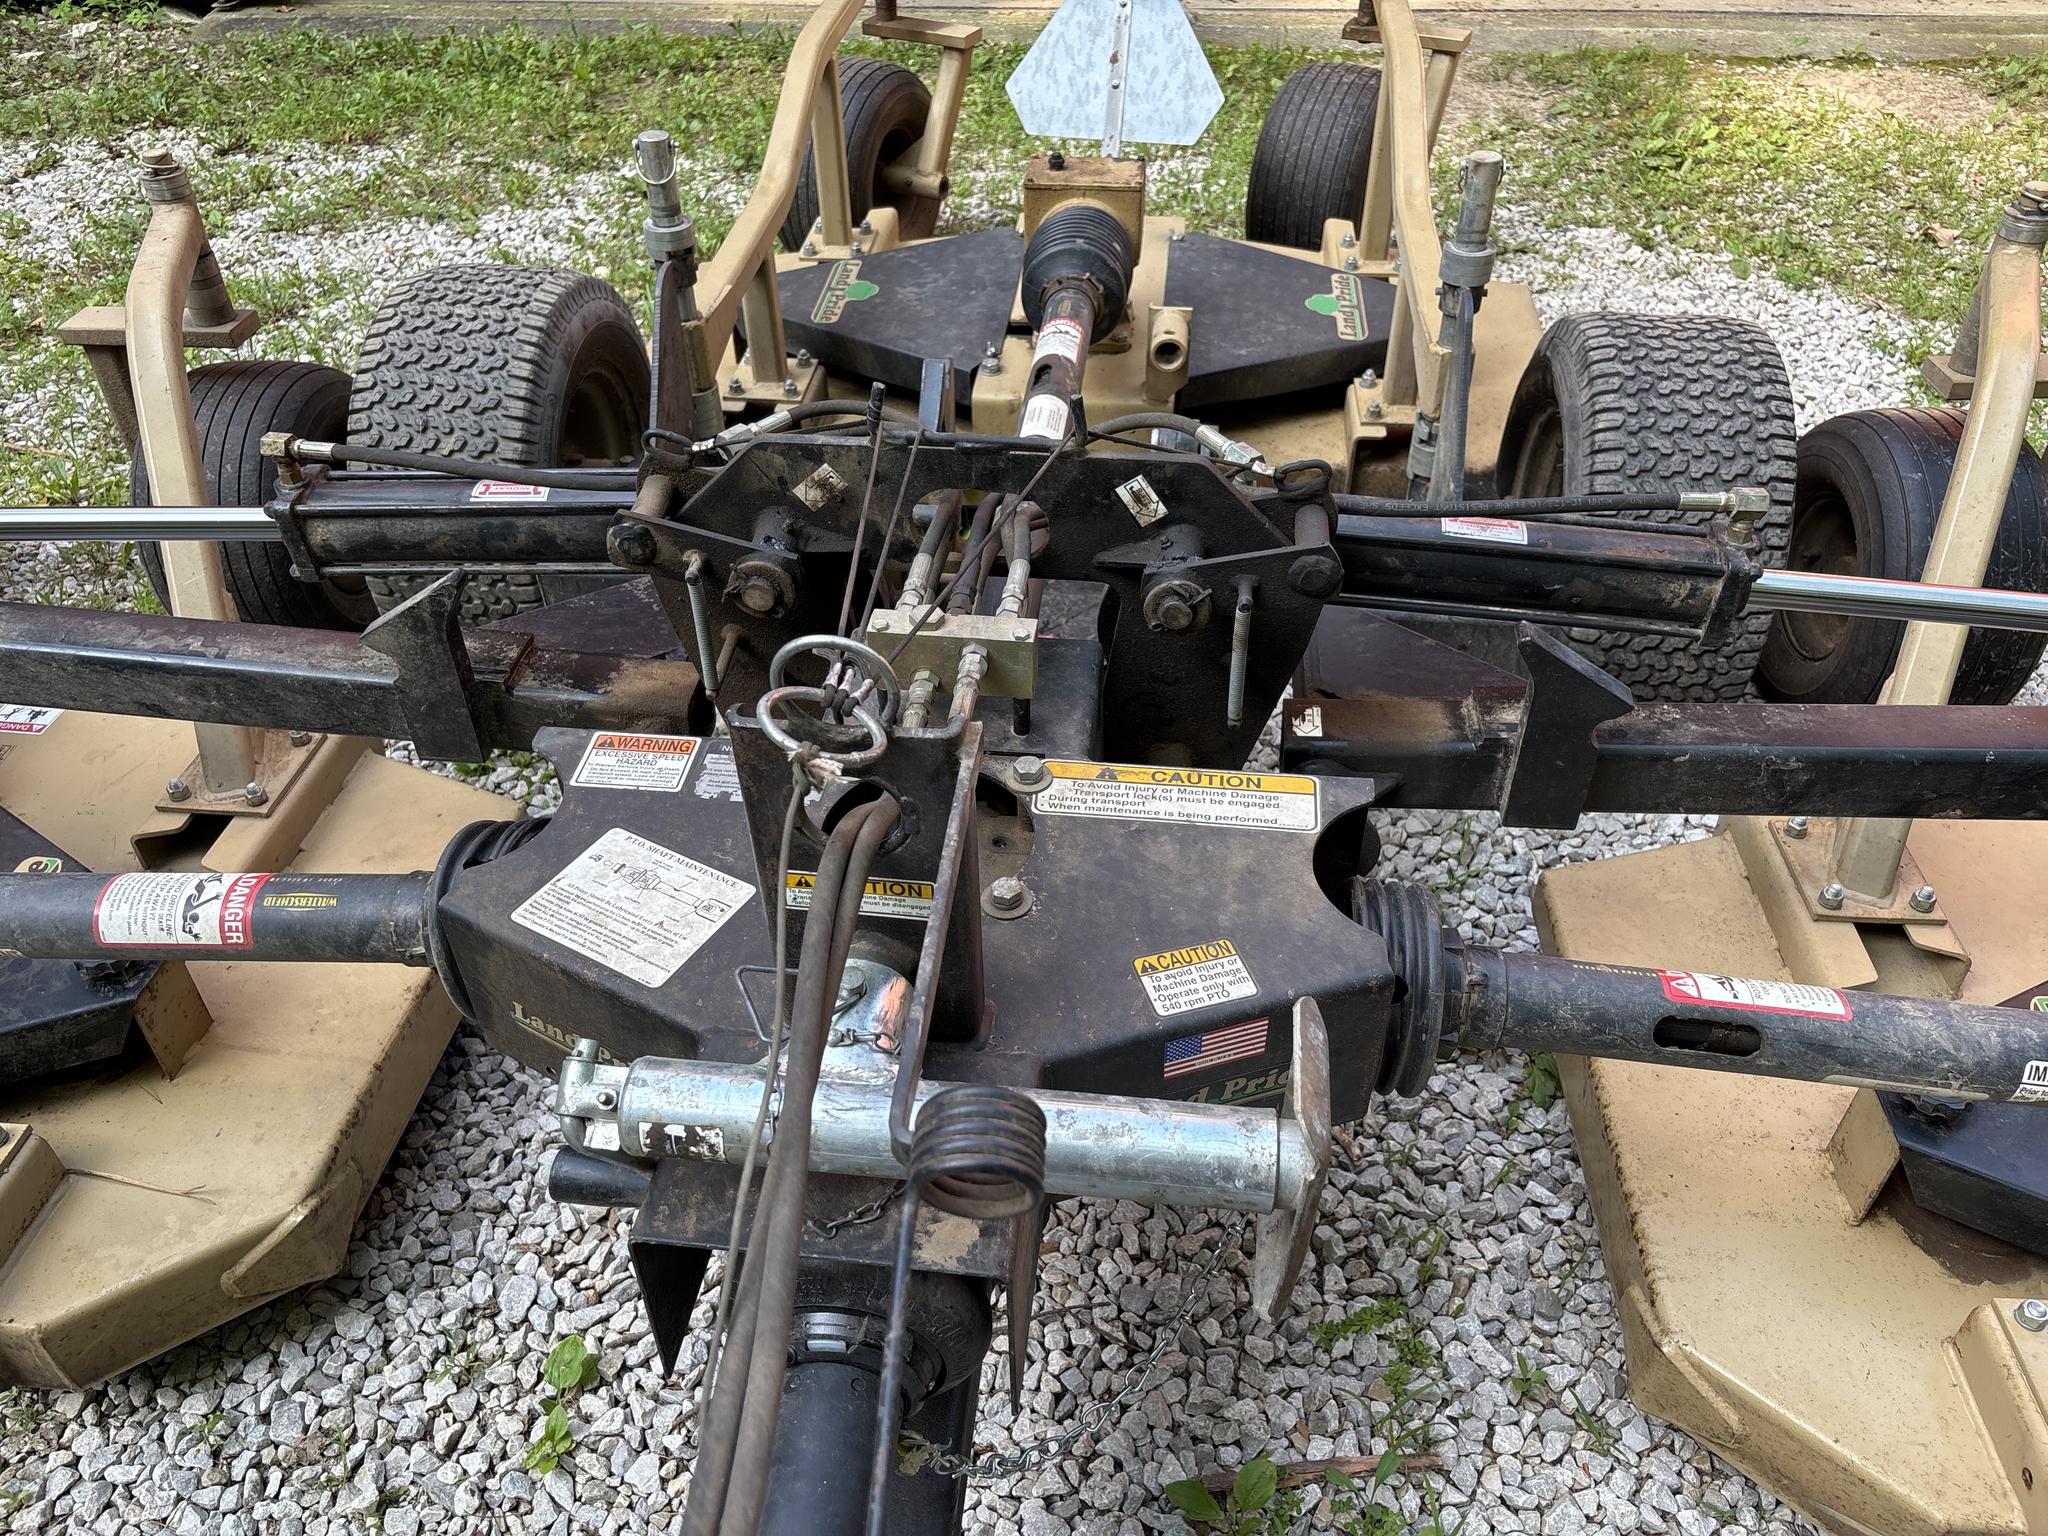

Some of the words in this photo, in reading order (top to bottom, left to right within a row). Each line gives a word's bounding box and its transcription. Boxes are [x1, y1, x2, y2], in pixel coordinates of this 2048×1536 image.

[837, 262, 860, 286] Land
[1334, 276, 1352, 302] Pride
[821, 294, 846, 322] Pride
[1338, 310, 1356, 337] Land
[1384, 502, 1428, 512] EXCEEDS
[1495, 500, 1526, 510] FLAME
[594, 750, 650, 759] EXCESSIVE
[618, 737, 691, 752] WARNING
[616, 758, 658, 766] HAZARD
[1151, 771, 1261, 788] CAUTION
[1049, 794, 1087, 804] During
[1092, 798, 1146, 807] transport
[1071, 780, 1084, 788] To
[1088, 782, 1121, 790] Avoid
[1124, 785, 1158, 794] Injury
[1178, 788, 1227, 797] Machine
[1231, 792, 1283, 802] Damage:
[1074, 788, 1130, 798] Transport
[1134, 792, 1172, 803] lock(s)
[1176, 796, 1206, 804] must
[1210, 797, 1224, 805] be
[1228, 801, 1280, 809] engaged
[1048, 802, 1080, 810] When
[1085, 805, 1160, 816] maintenance
[1178, 811, 1211, 821] being
[1215, 815, 1277, 825] performed
[624, 835, 648, 848] P.T.O.
[646, 844, 676, 860] SHAFT
[674, 856, 738, 888] MAINTENANCE
[144, 880, 162, 905] OPERATE
[160, 877, 174, 892] KEEP
[867, 881, 922, 897] TION
[149, 893, 161, 920] AWAY!
[159, 895, 169, 911] CAUSE
[224, 878, 255, 943] DANGER
[263, 896, 337, 906] WALTERSCHEID
[573, 885, 590, 895] Points
[587, 891, 606, 902] Should
[611, 902, 640, 918] Lubricated
[637, 915, 654, 925] Every
[656, 923, 674, 934] Hours
[1157, 940, 1233, 969] CAUTION
[1148, 975, 1162, 983] To
[1165, 968, 1193, 981] avoid
[1194, 960, 1224, 974] Injury
[1227, 957, 1238, 965] or
[1152, 978, 1198, 993] Machine
[1199, 966, 1246, 982] Damage:
[1158, 988, 1200, 1002] Operate
[1202, 982, 1224, 992] only
[1227, 976, 1250, 986] with
[1162, 1001, 1182, 1012] 540
[1184, 997, 1205, 1008] rpm
[1207, 990, 1230, 1002] PTO
[512, 1001, 580, 1048] Land
[1220, 1069, 1289, 1100] Pri
[2027, 1065, 2048, 1082] IM
[2019, 1087, 2040, 1095] Prior
